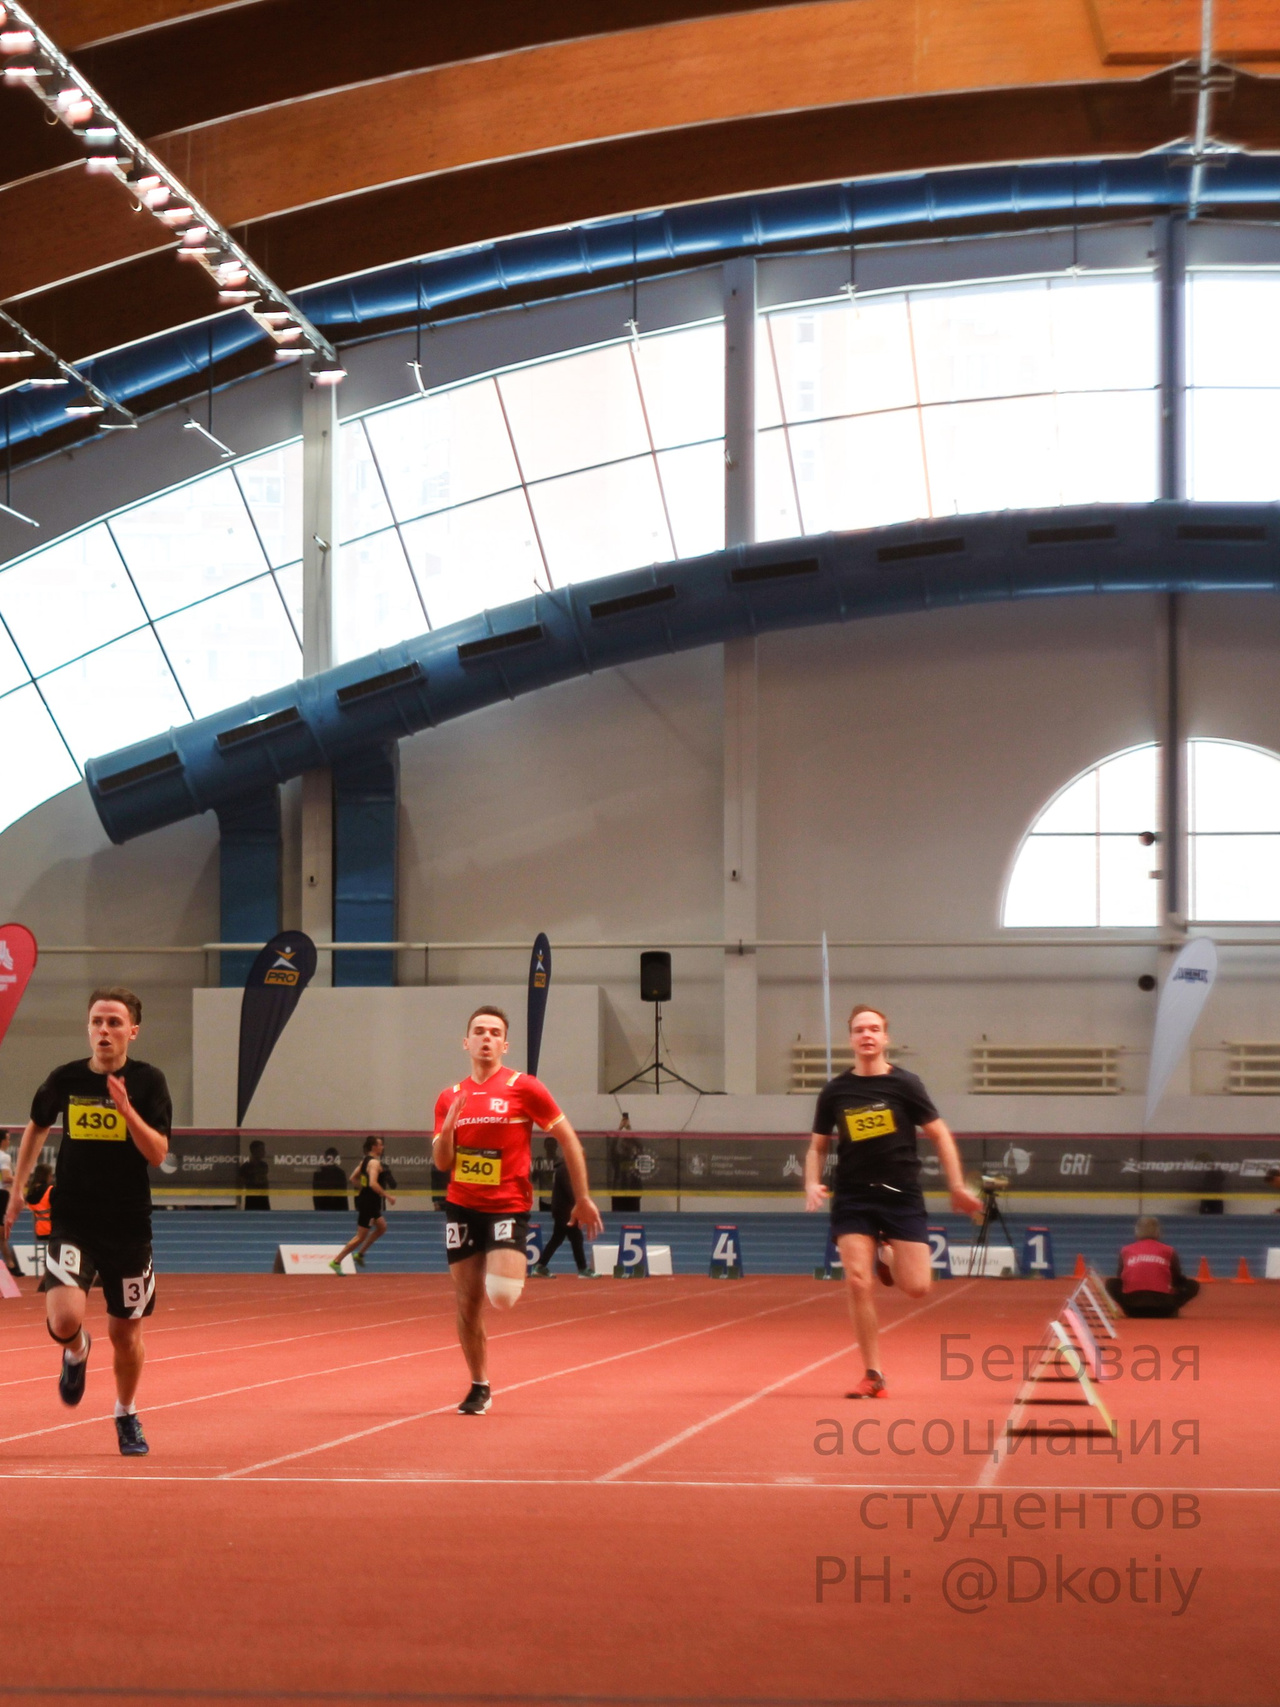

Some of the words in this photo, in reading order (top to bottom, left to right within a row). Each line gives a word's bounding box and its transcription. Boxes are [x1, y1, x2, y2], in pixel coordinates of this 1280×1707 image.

[267, 972, 296, 983] PRO
[76, 1112, 117, 1130] 430
[855, 1114, 886, 1132] 332
[182, 1163, 213, 1171] СПОРТ
[183, 1155, 202, 1163] РИА
[205, 1155, 250, 1163] НОВОСТИ
[274, 1154, 342, 1166] МОСКВА24
[461, 1160, 493, 1176] 540
[448, 1228, 456, 1244] 2
[498, 1223, 507, 1236] 2
[622, 1232, 644, 1267] 5
[712, 1232, 737, 1267] 4
[930, 1234, 948, 1268] 2
[1027, 1234, 1049, 1269] 1
[65, 1250, 76, 1267] 3
[128, 1283, 141, 1302] 3
